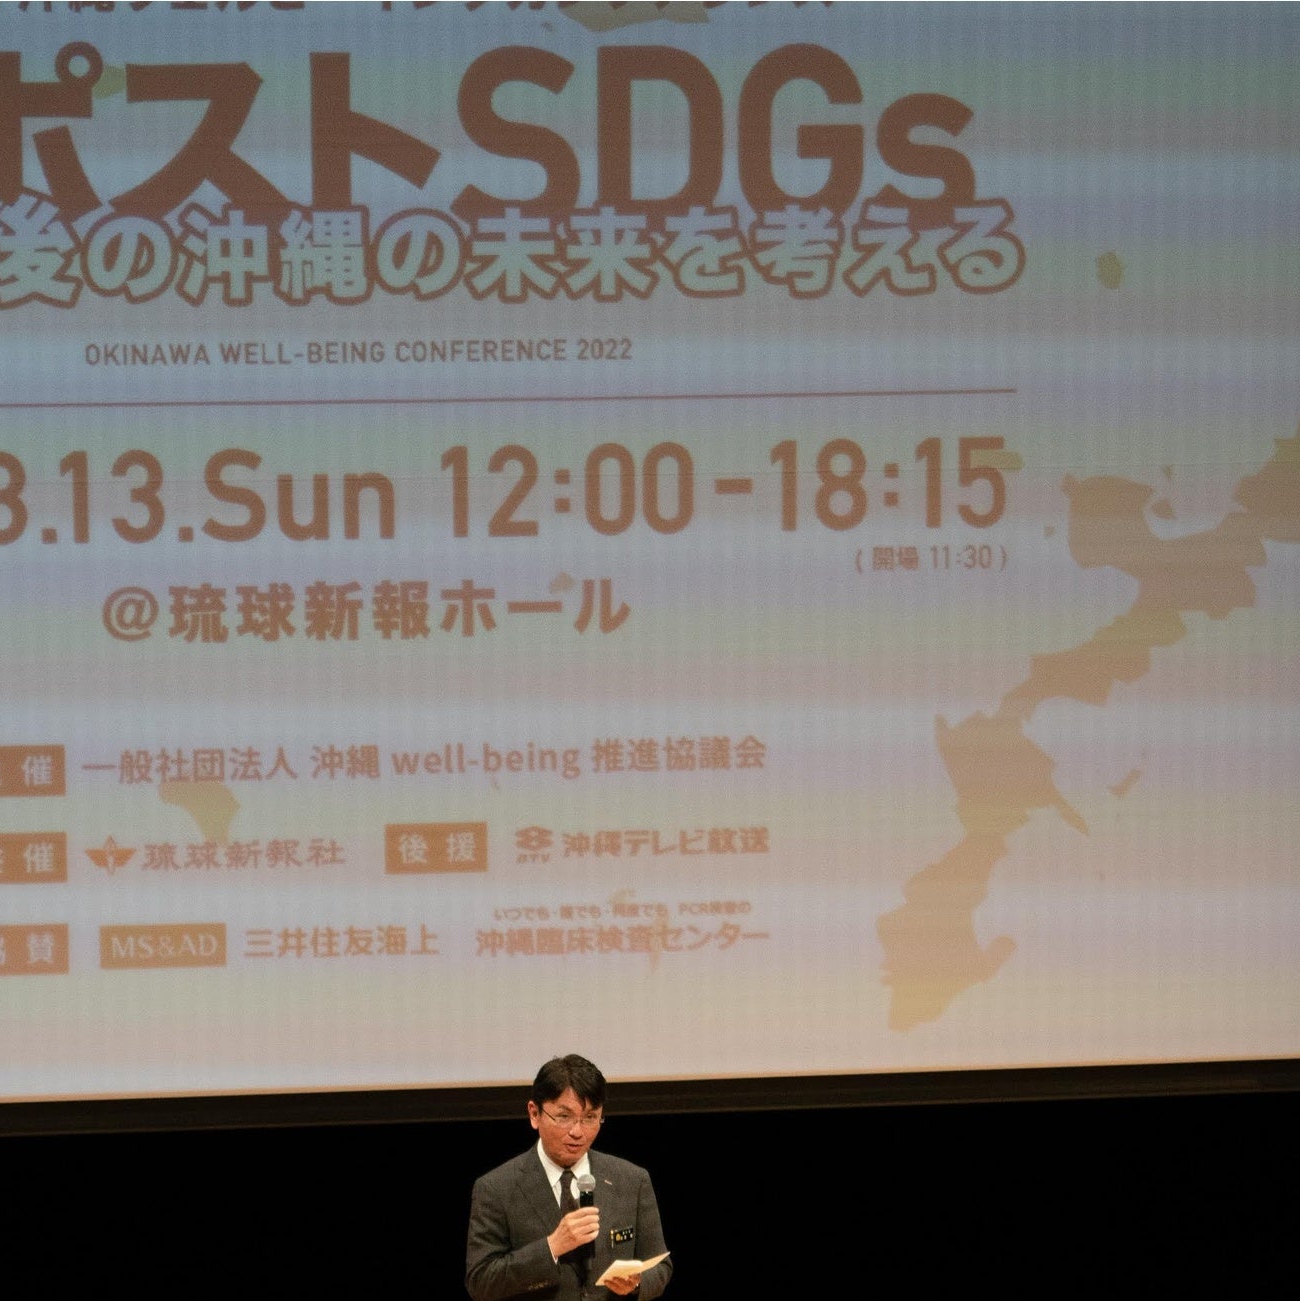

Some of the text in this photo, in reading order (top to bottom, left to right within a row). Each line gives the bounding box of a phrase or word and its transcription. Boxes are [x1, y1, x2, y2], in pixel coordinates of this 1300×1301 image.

[85, 337, 633, 367] OKINAWA WELL-BEING CONFERENCE 2022
[102, 578, 631, 643] @琉球新報ホール
[82, 747, 299, 785] 一般社団法人
[311, 743, 381, 780] 沖縄
[390, 742, 581, 780] well-being
[592, 735, 768, 773] 推進協議会
[109, 933, 220, 961] MS&AD
[243, 924, 440, 959] 三井住友海上
